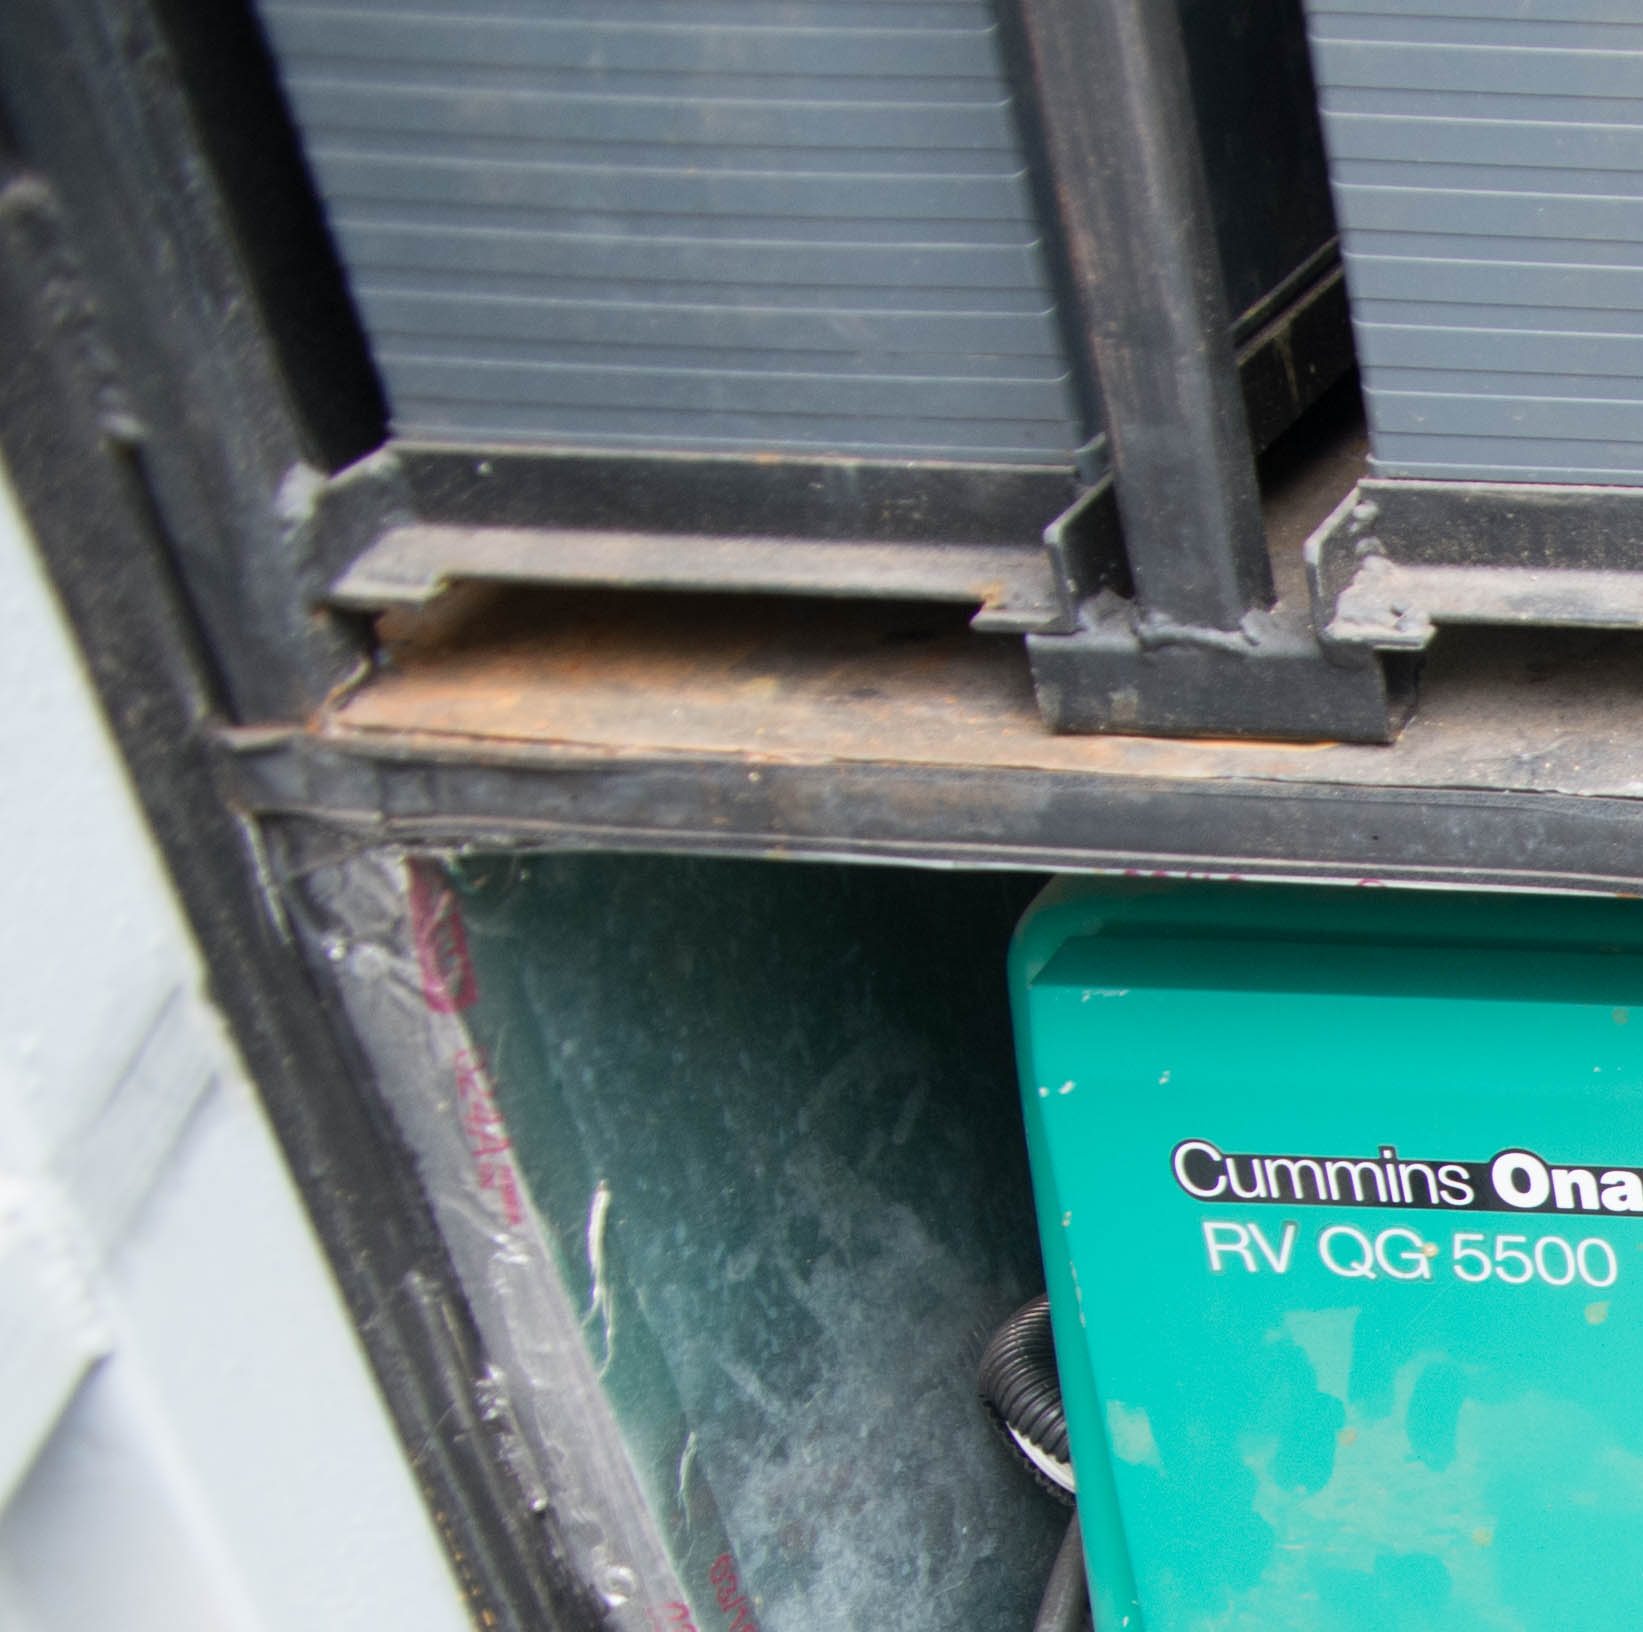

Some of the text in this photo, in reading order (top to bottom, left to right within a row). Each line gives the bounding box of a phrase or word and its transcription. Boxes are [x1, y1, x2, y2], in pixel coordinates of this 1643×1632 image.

[1172, 1140, 1474, 1206] Cummins
[1201, 1220, 1618, 1287] RV QG 5500
